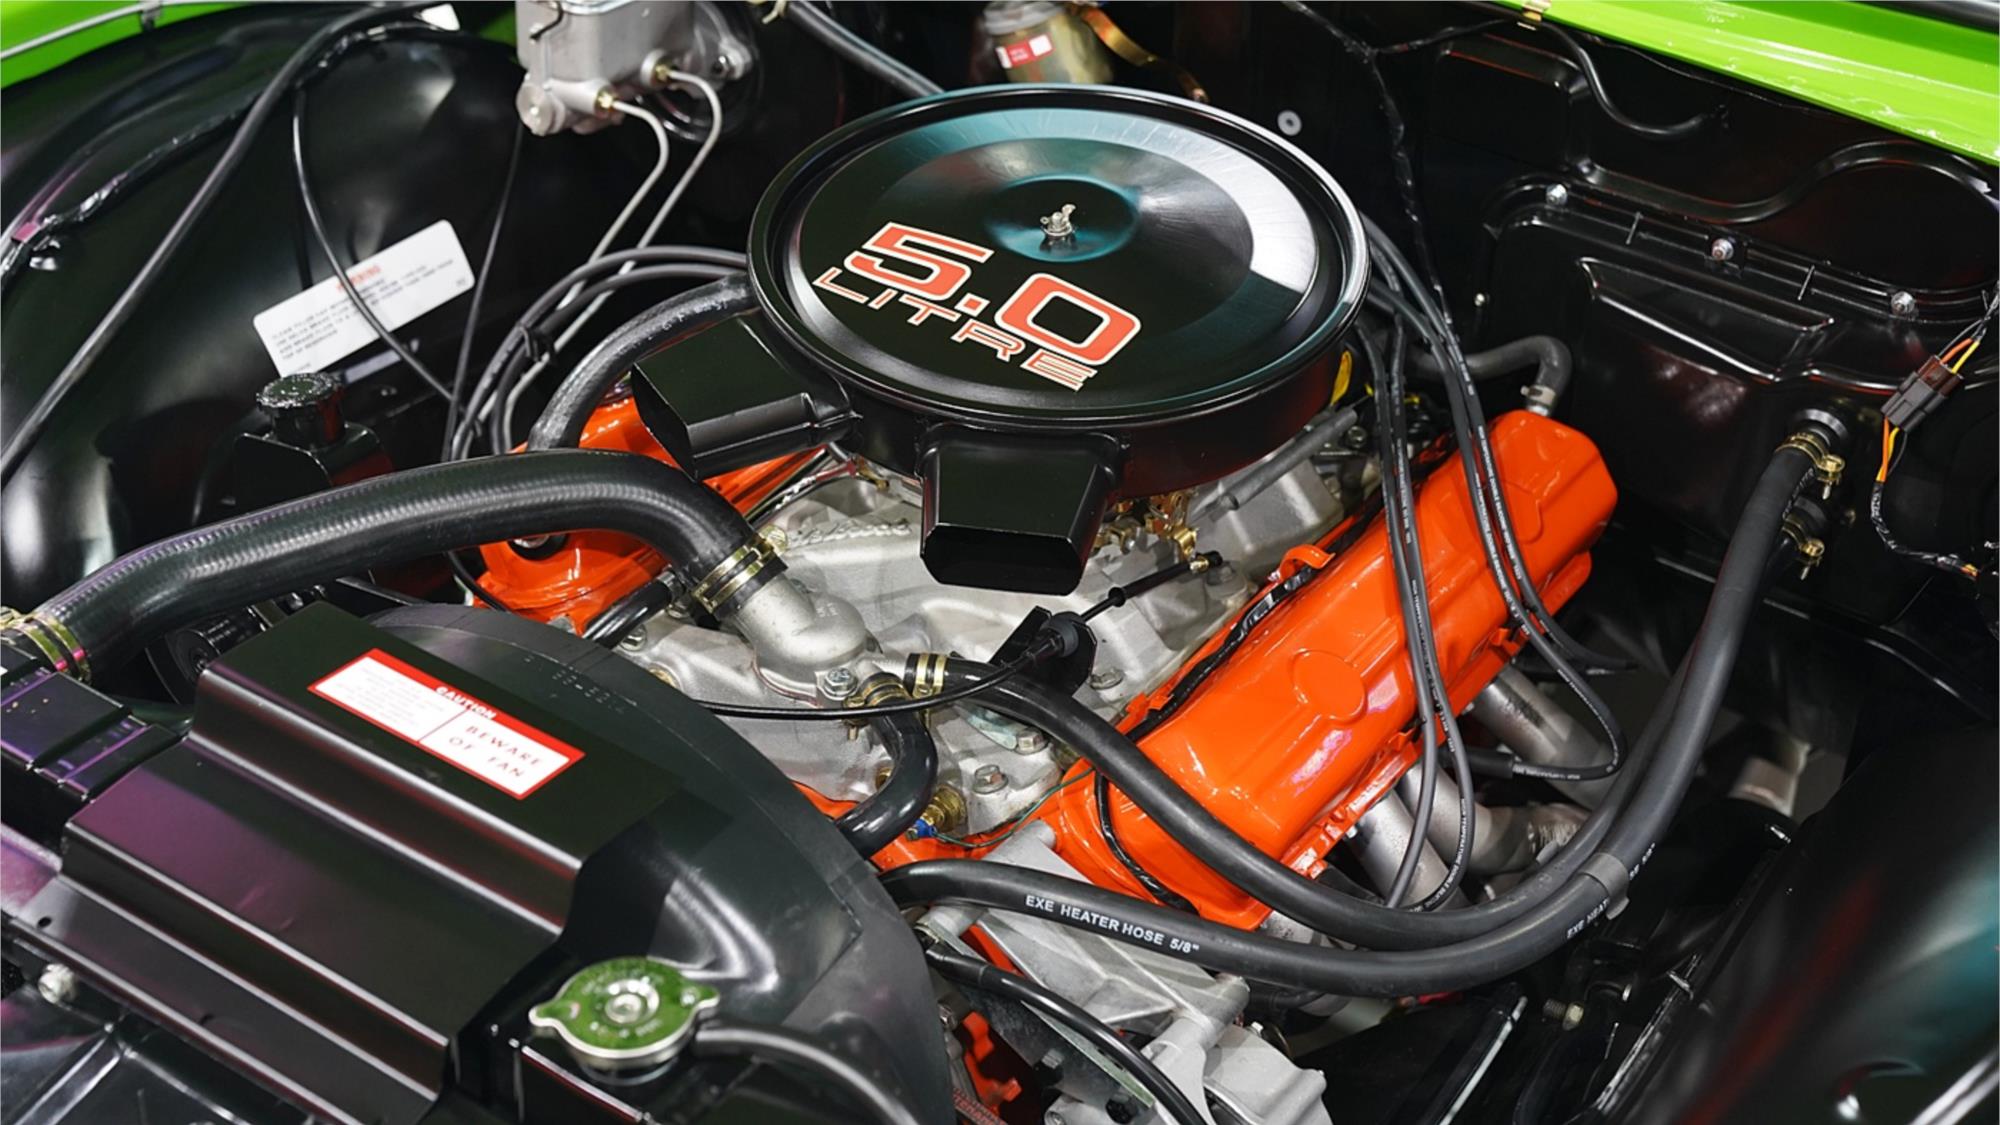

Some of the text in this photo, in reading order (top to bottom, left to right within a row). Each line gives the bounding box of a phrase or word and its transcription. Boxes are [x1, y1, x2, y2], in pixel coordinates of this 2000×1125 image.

[844, 222, 1141, 365] 5.0
[812, 267, 1098, 391] LITRE
[435, 686, 497, 720] CAUTION
[449, 736, 525, 778] OF FAN
[465, 725, 542, 767] BEWARE
[1025, 895, 1200, 954] EXE HEATER HOSE 5/8"
